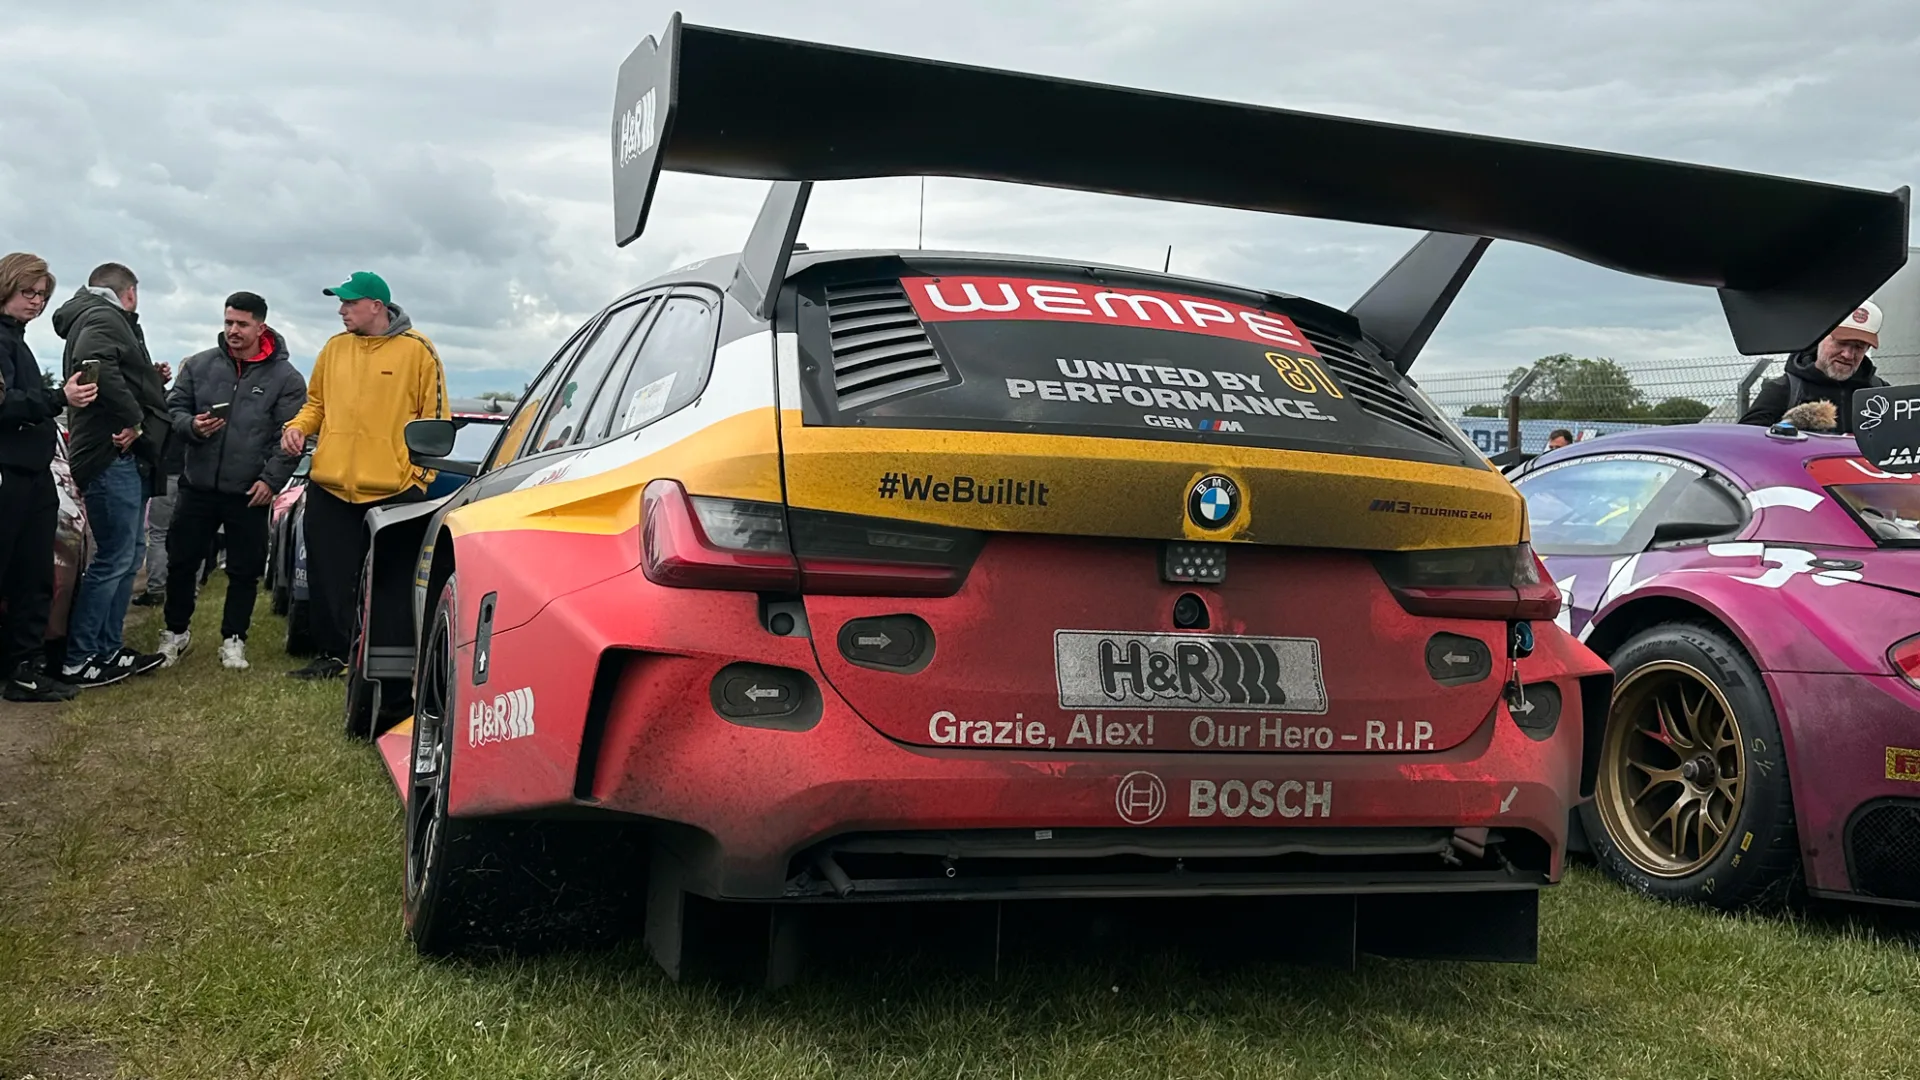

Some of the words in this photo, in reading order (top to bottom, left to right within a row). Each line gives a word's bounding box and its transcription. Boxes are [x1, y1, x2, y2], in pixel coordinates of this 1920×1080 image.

[923, 282, 1302, 347] WEMPE
[1055, 358, 1209, 389] UNITED
[1212, 370, 1265, 393] BY
[1264, 352, 1344, 400] 81
[1005, 378, 1338, 423] PERFORMANCE.
[1143, 414, 1193, 430] GEN
[878, 472, 1050, 506] #WeBuiltIt
[1196, 478, 1236, 496] BMW
[1376, 499, 1411, 514] M3
[1411, 506, 1468, 518] TOURING
[1469, 511, 1493, 520] 24H
[1098, 638, 1230, 704] H&R
[928, 710, 1056, 749] Grazie,
[1066, 713, 1154, 745] Alex!
[1189, 715, 1251, 748] Our
[1258, 717, 1334, 749] Hero
[1365, 720, 1434, 750] R.I.P.
[1188, 779, 1333, 818] BOSCH
